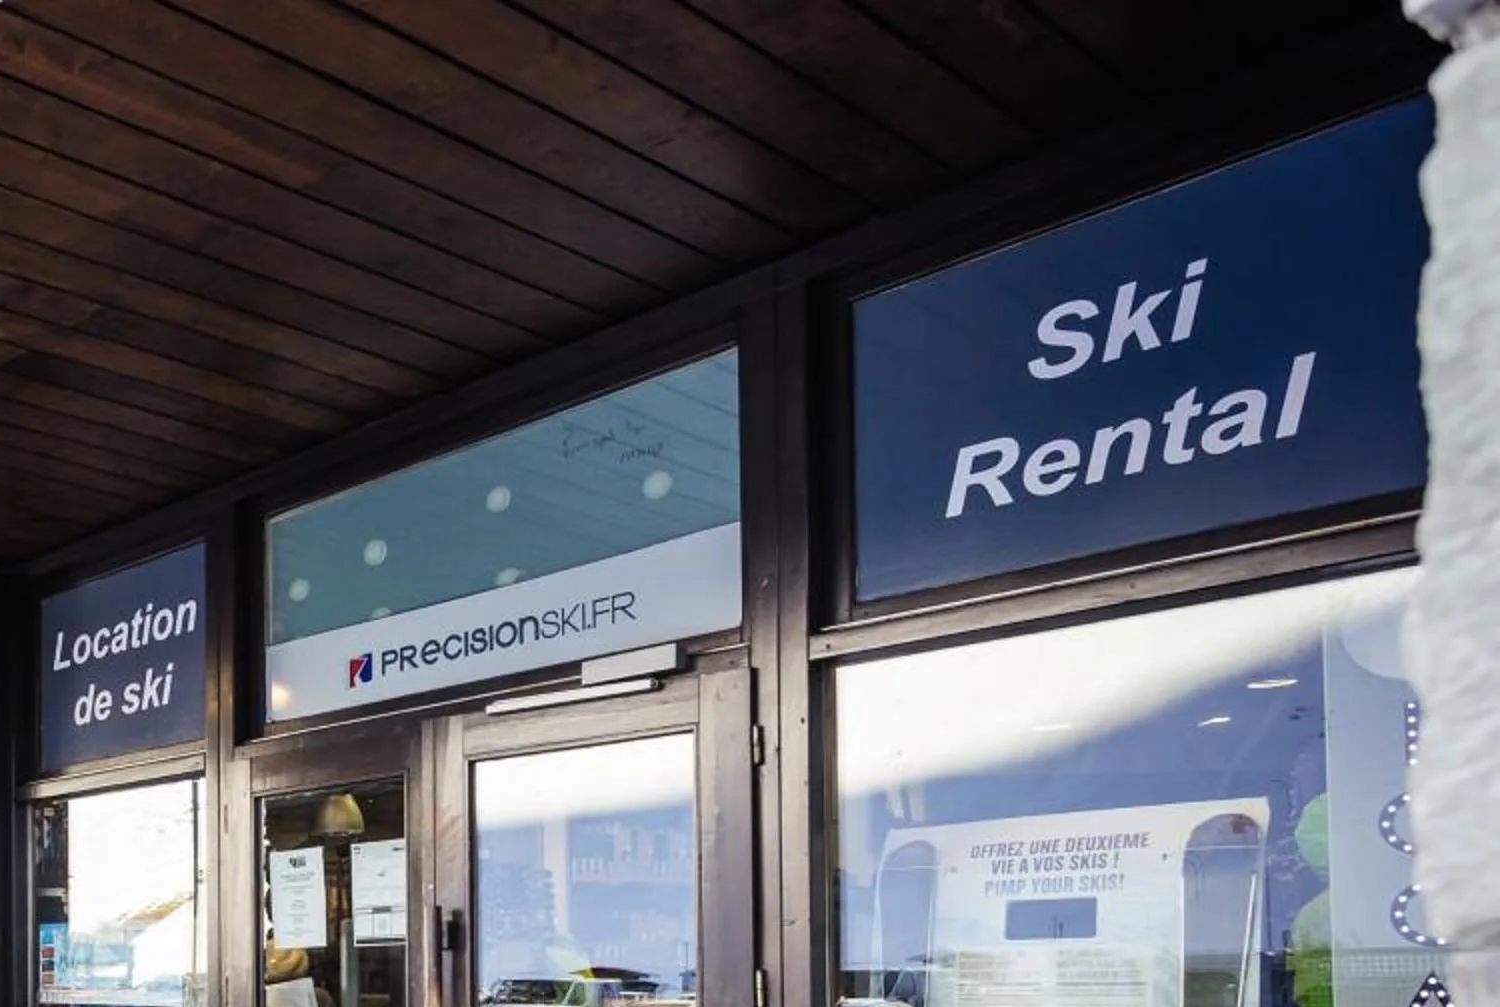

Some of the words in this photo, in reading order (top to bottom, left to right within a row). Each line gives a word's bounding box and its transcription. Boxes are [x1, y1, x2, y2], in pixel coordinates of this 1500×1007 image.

[1027, 257, 1209, 381] Ski
[944, 351, 1317, 520] Rental
[53, 599, 197, 673] Location
[73, 683, 113, 727] de
[121, 661, 175, 715] ski
[969, 841, 1025, 860] OFFREZ
[1029, 838, 1061, 855] UNE
[1064, 831, 1151, 854] DEUXIEME
[991, 858, 1015, 876] VIE
[1032, 855, 1065, 873] VOS
[1068, 852, 1109, 872] SKIS
[983, 878, 1027, 898] PIMP
[1031, 876, 1074, 894] YOUR
[1077, 873, 1125, 893] SKIS!
